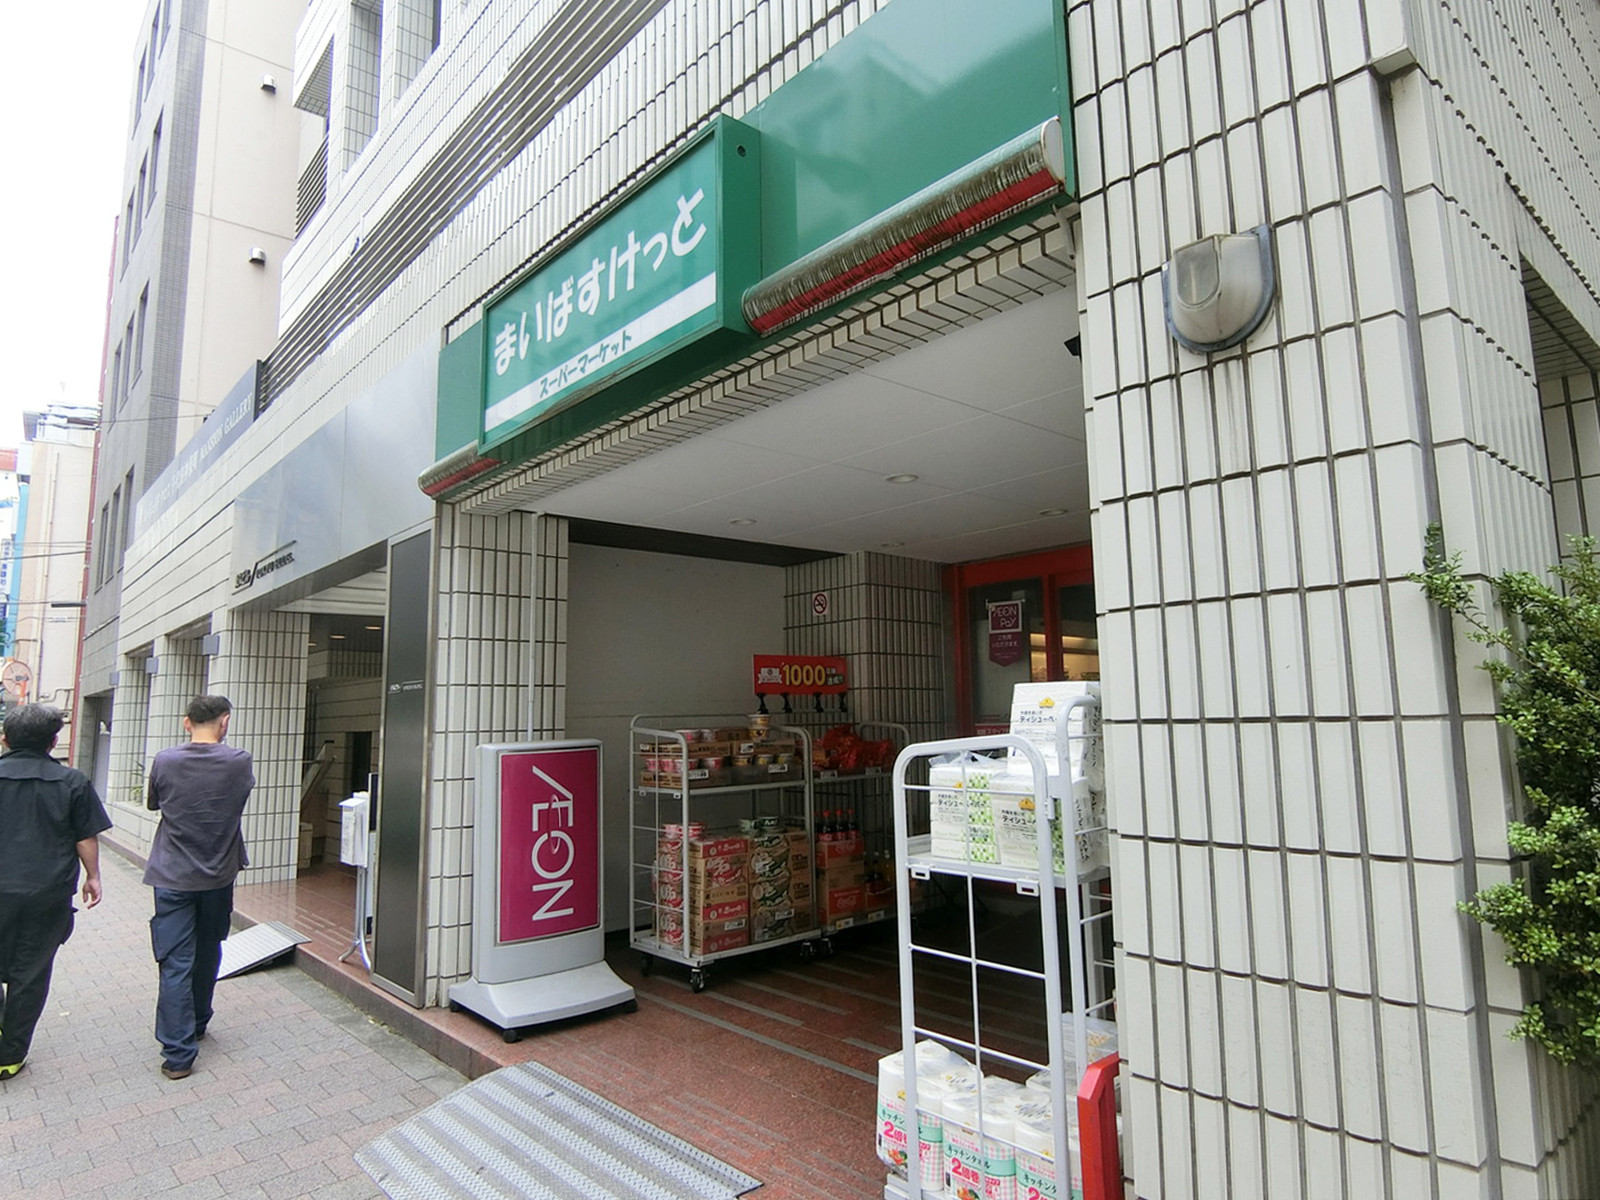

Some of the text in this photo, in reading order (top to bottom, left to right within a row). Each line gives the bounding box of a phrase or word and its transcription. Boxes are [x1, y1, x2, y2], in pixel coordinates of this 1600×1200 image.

[493, 188, 707, 376] まいばすけっと
[539, 329, 632, 398] スーパーマーケット
[223, 392, 253, 434] GALLERY
[782, 664, 826, 686] 1000
